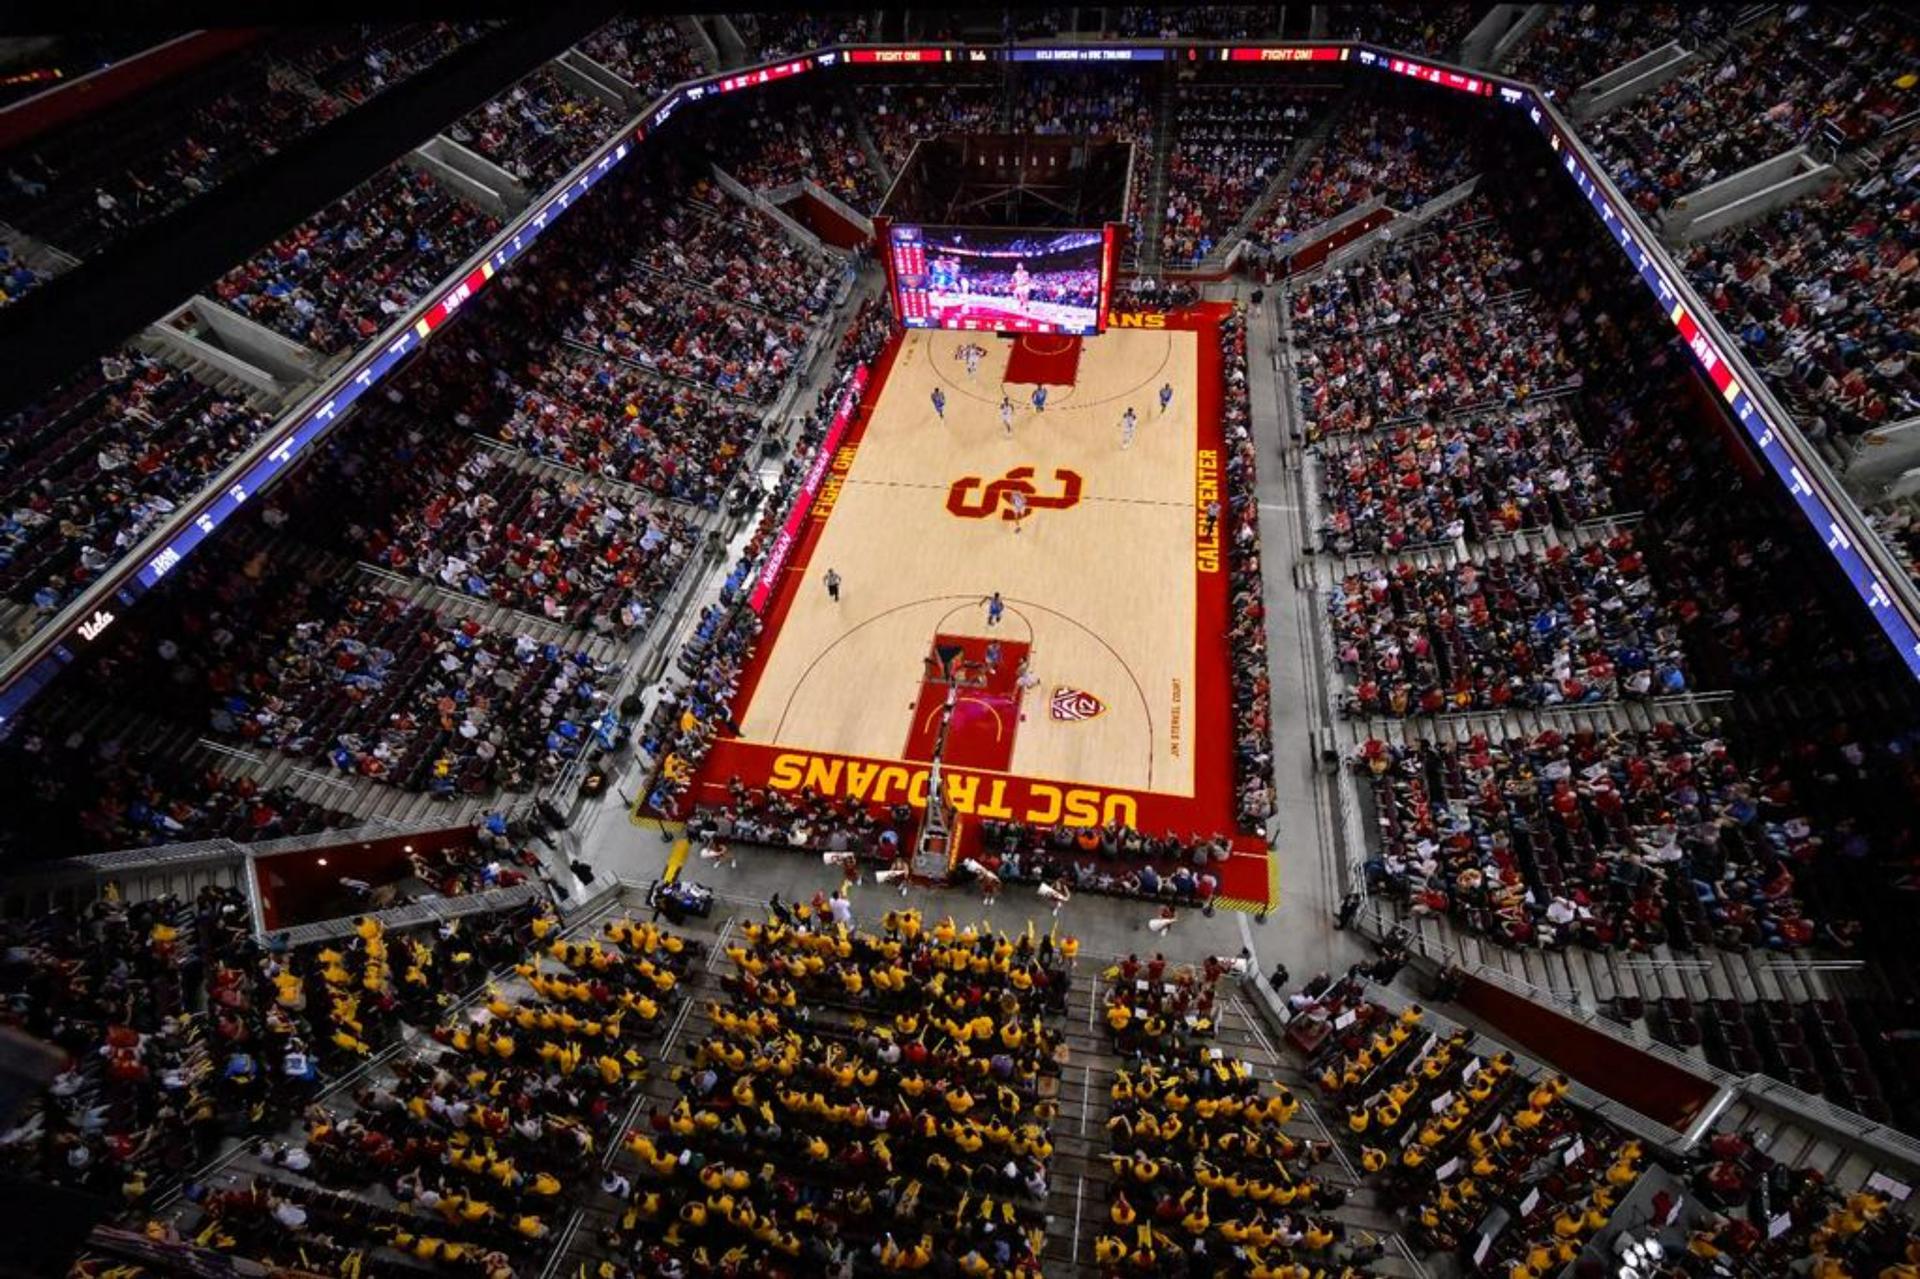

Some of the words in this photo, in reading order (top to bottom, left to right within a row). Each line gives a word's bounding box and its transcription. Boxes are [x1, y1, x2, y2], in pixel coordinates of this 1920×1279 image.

[875, 50, 903, 61] FIGHT
[1261, 49, 1293, 61] FIGHT
[805, 449, 830, 494] NISSAN
[811, 471, 846, 518] FIGHT
[1197, 449, 1219, 510] CENTER
[762, 531, 792, 587] NISSAN
[768, 753, 1014, 818] TROJANS
[1024, 785, 1138, 830] USC
